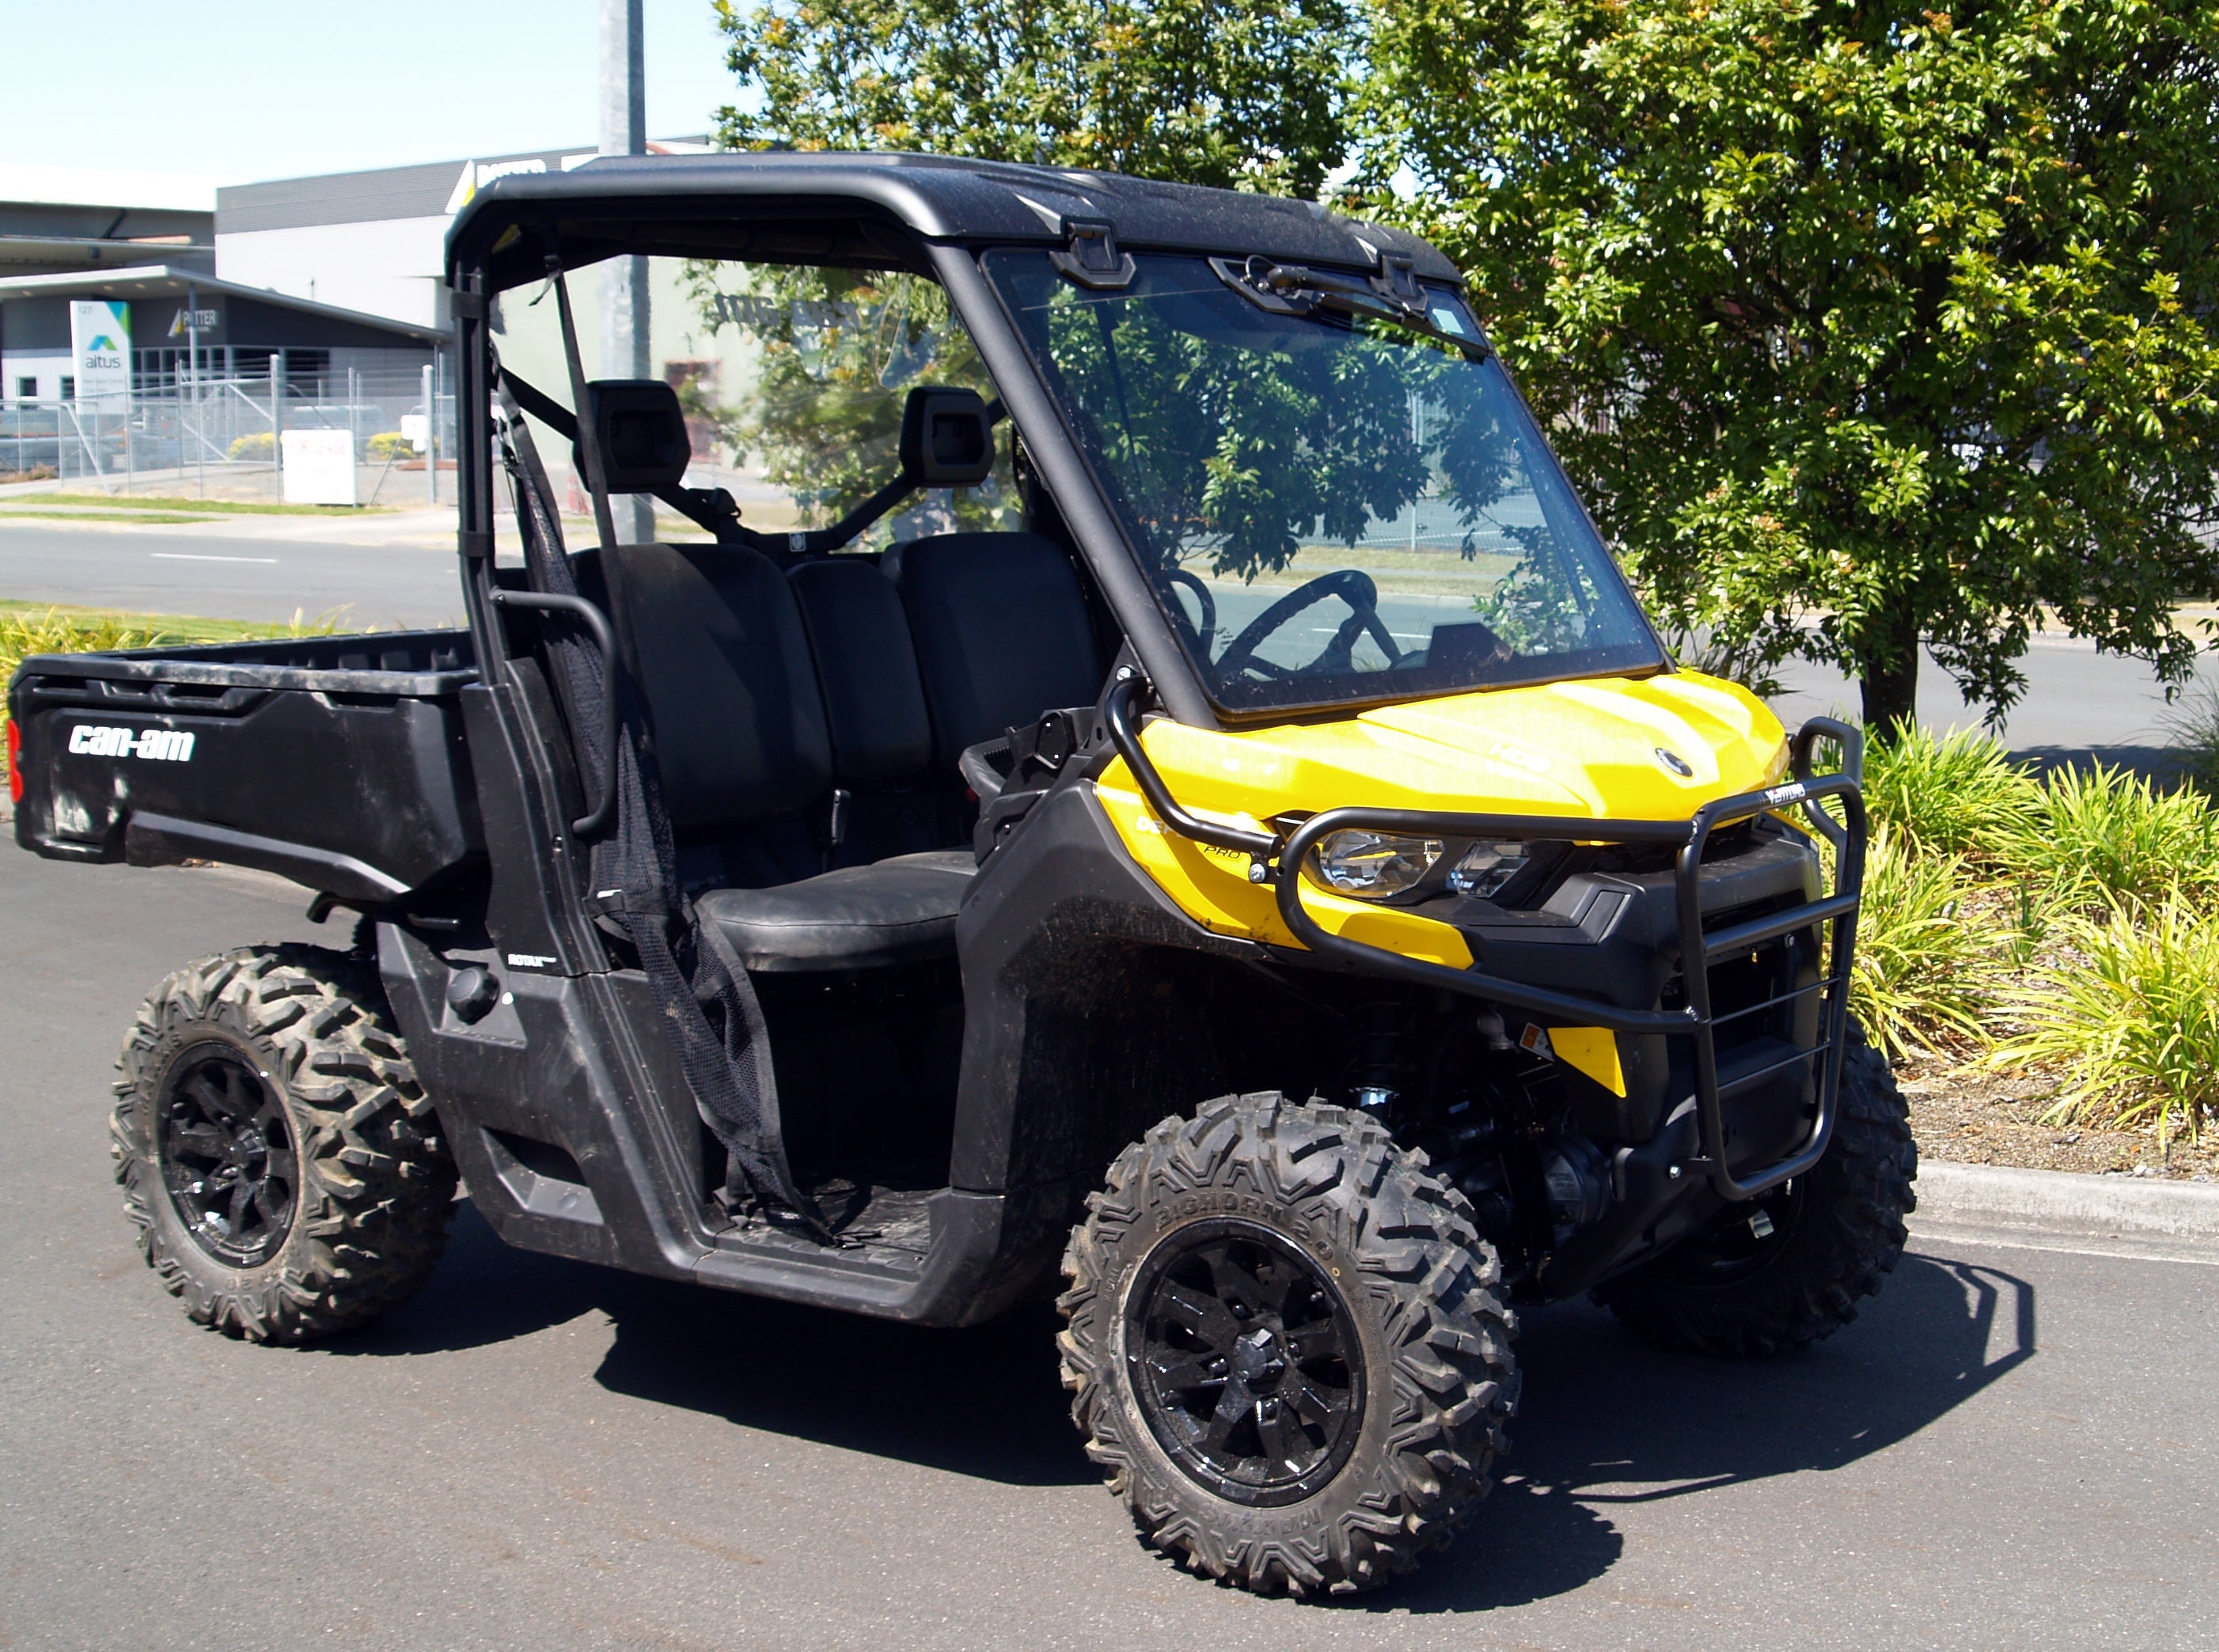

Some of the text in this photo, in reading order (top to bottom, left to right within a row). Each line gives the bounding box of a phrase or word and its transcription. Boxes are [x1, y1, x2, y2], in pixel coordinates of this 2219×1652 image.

[85, 354, 121, 369] altus
[68, 725, 195, 762] can-am
[1204, 845, 1241, 859] PRO
[1155, 1190, 1284, 1233] BIGHORN
